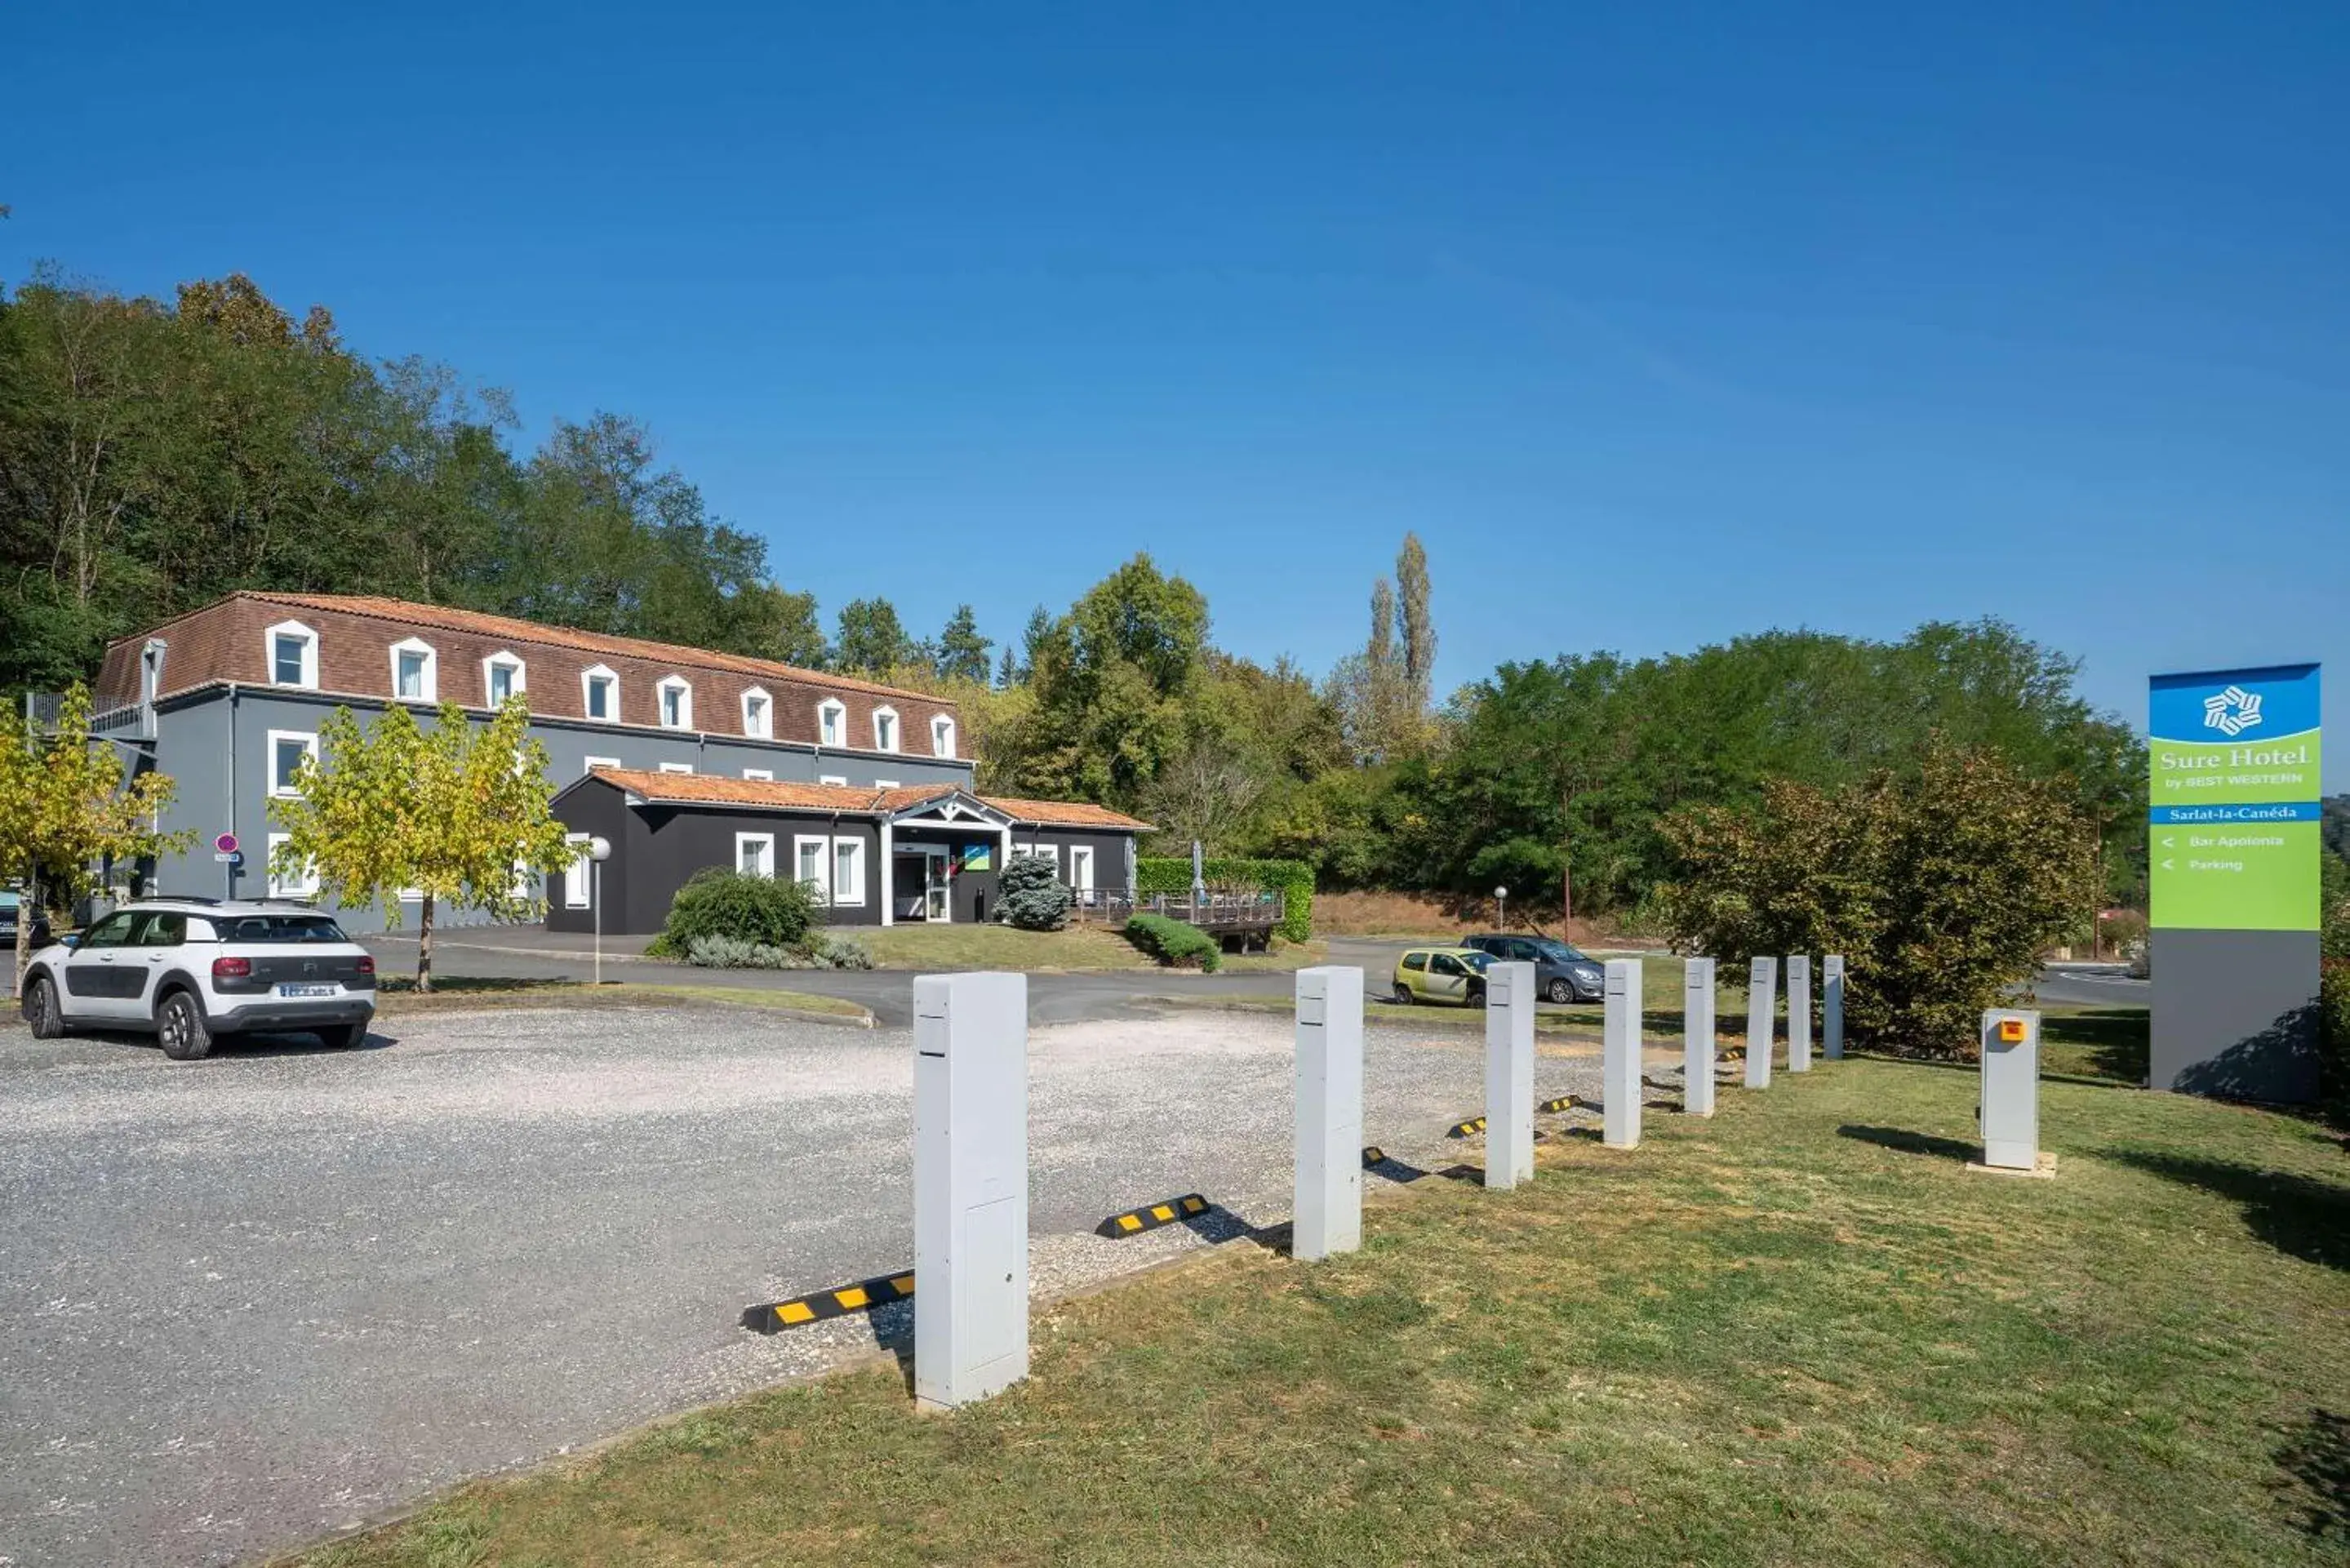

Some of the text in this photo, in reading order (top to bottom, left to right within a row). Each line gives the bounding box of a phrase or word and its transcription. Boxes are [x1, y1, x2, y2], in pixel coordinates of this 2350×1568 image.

[2161, 744, 2312, 770] Sure Hotel
[2166, 773, 2303, 789] by BEST WESTERN
[2170, 806, 2298, 820] Sarlat-la-Canéda
[2190, 836, 2284, 847] Bar Apolonia
[2190, 860, 2243, 872] Parking
